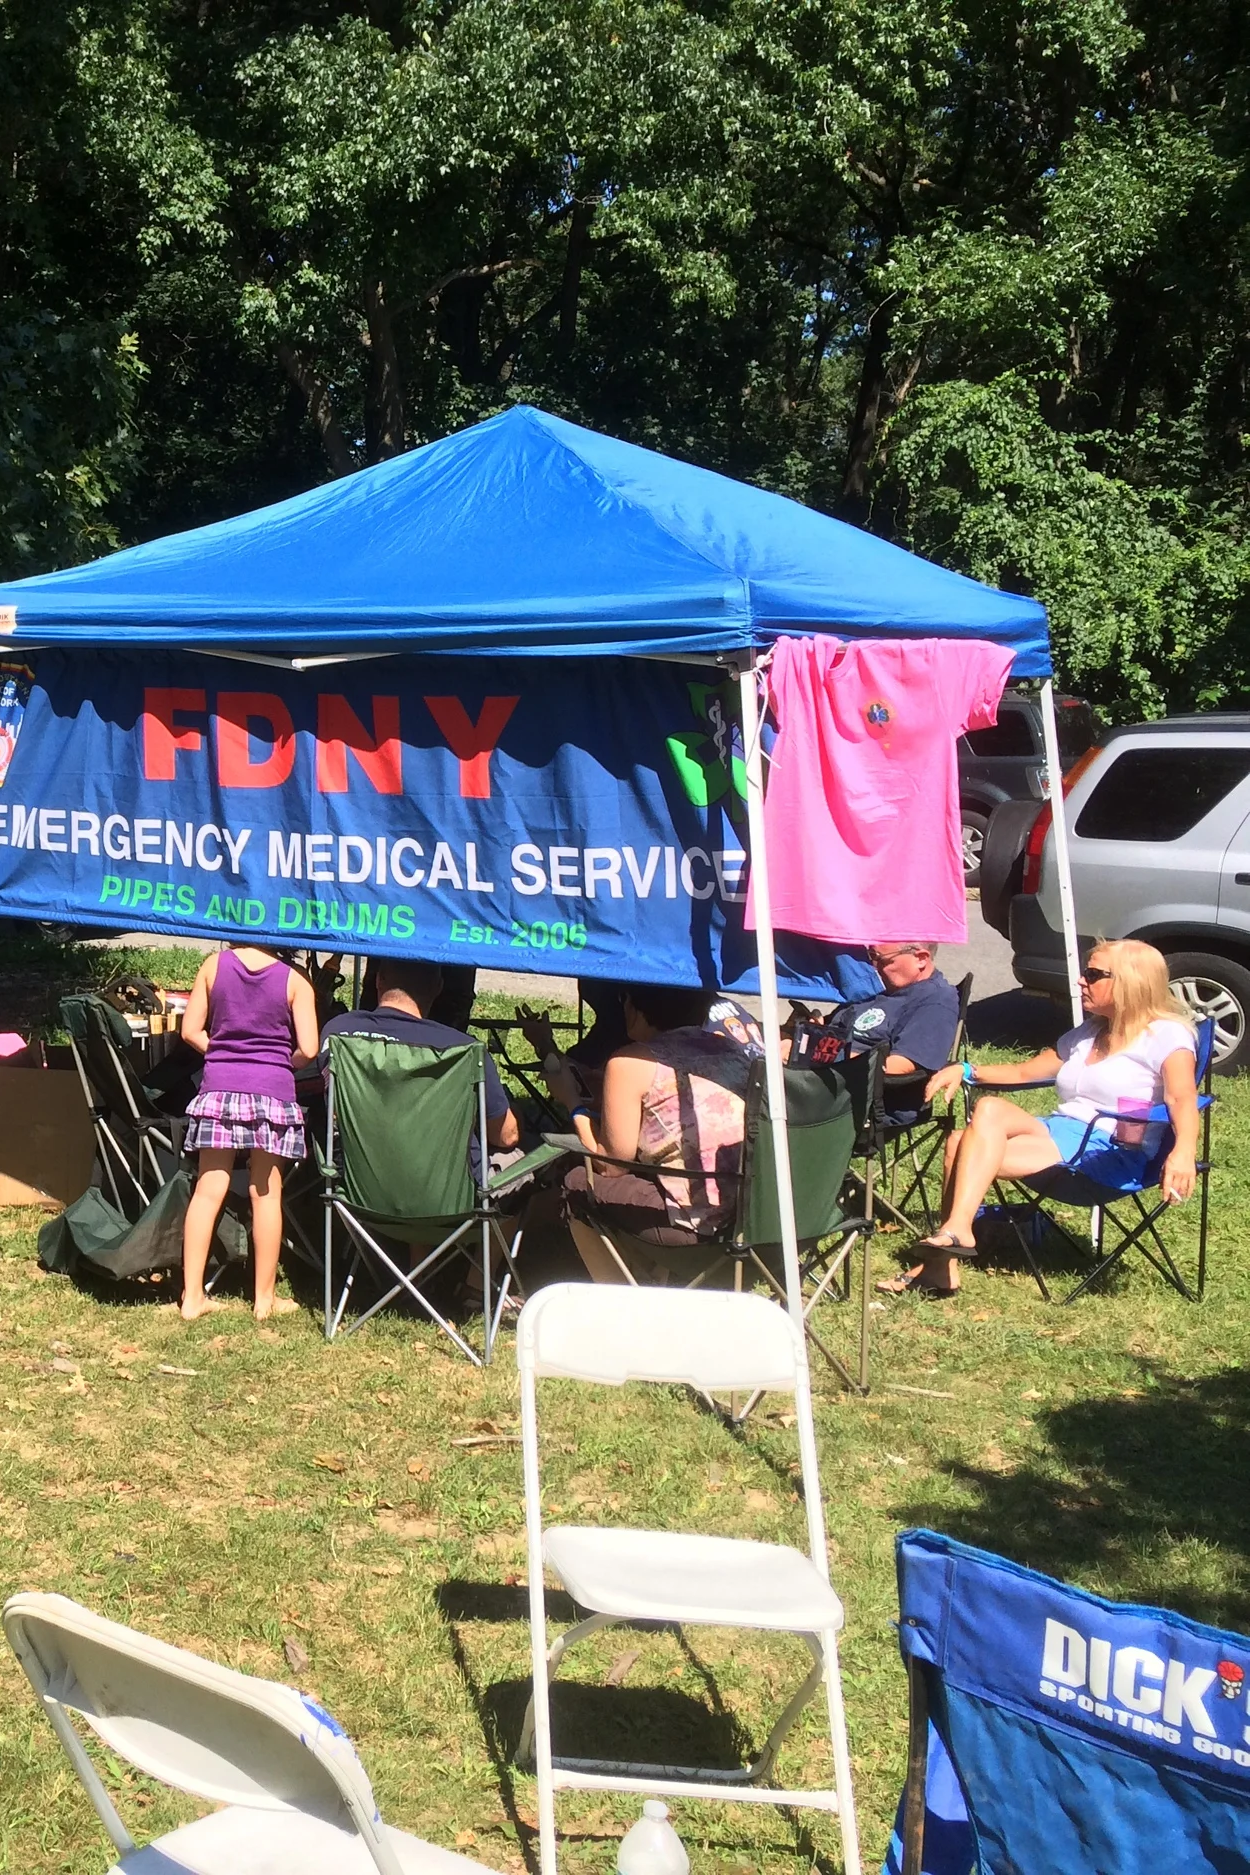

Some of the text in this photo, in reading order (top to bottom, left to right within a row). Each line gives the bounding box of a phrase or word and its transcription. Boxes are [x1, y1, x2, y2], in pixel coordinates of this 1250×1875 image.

[143, 686, 521, 798] FDNY
[267, 831, 494, 893] MEDICAL
[511, 840, 746, 902] SERVICE
[98, 874, 196, 915] PIPES
[203, 894, 266, 926] AND
[277, 897, 417, 939] DRUMS
[510, 920, 588, 950] 2006
[1039, 1679, 1181, 1745] SPORTING
